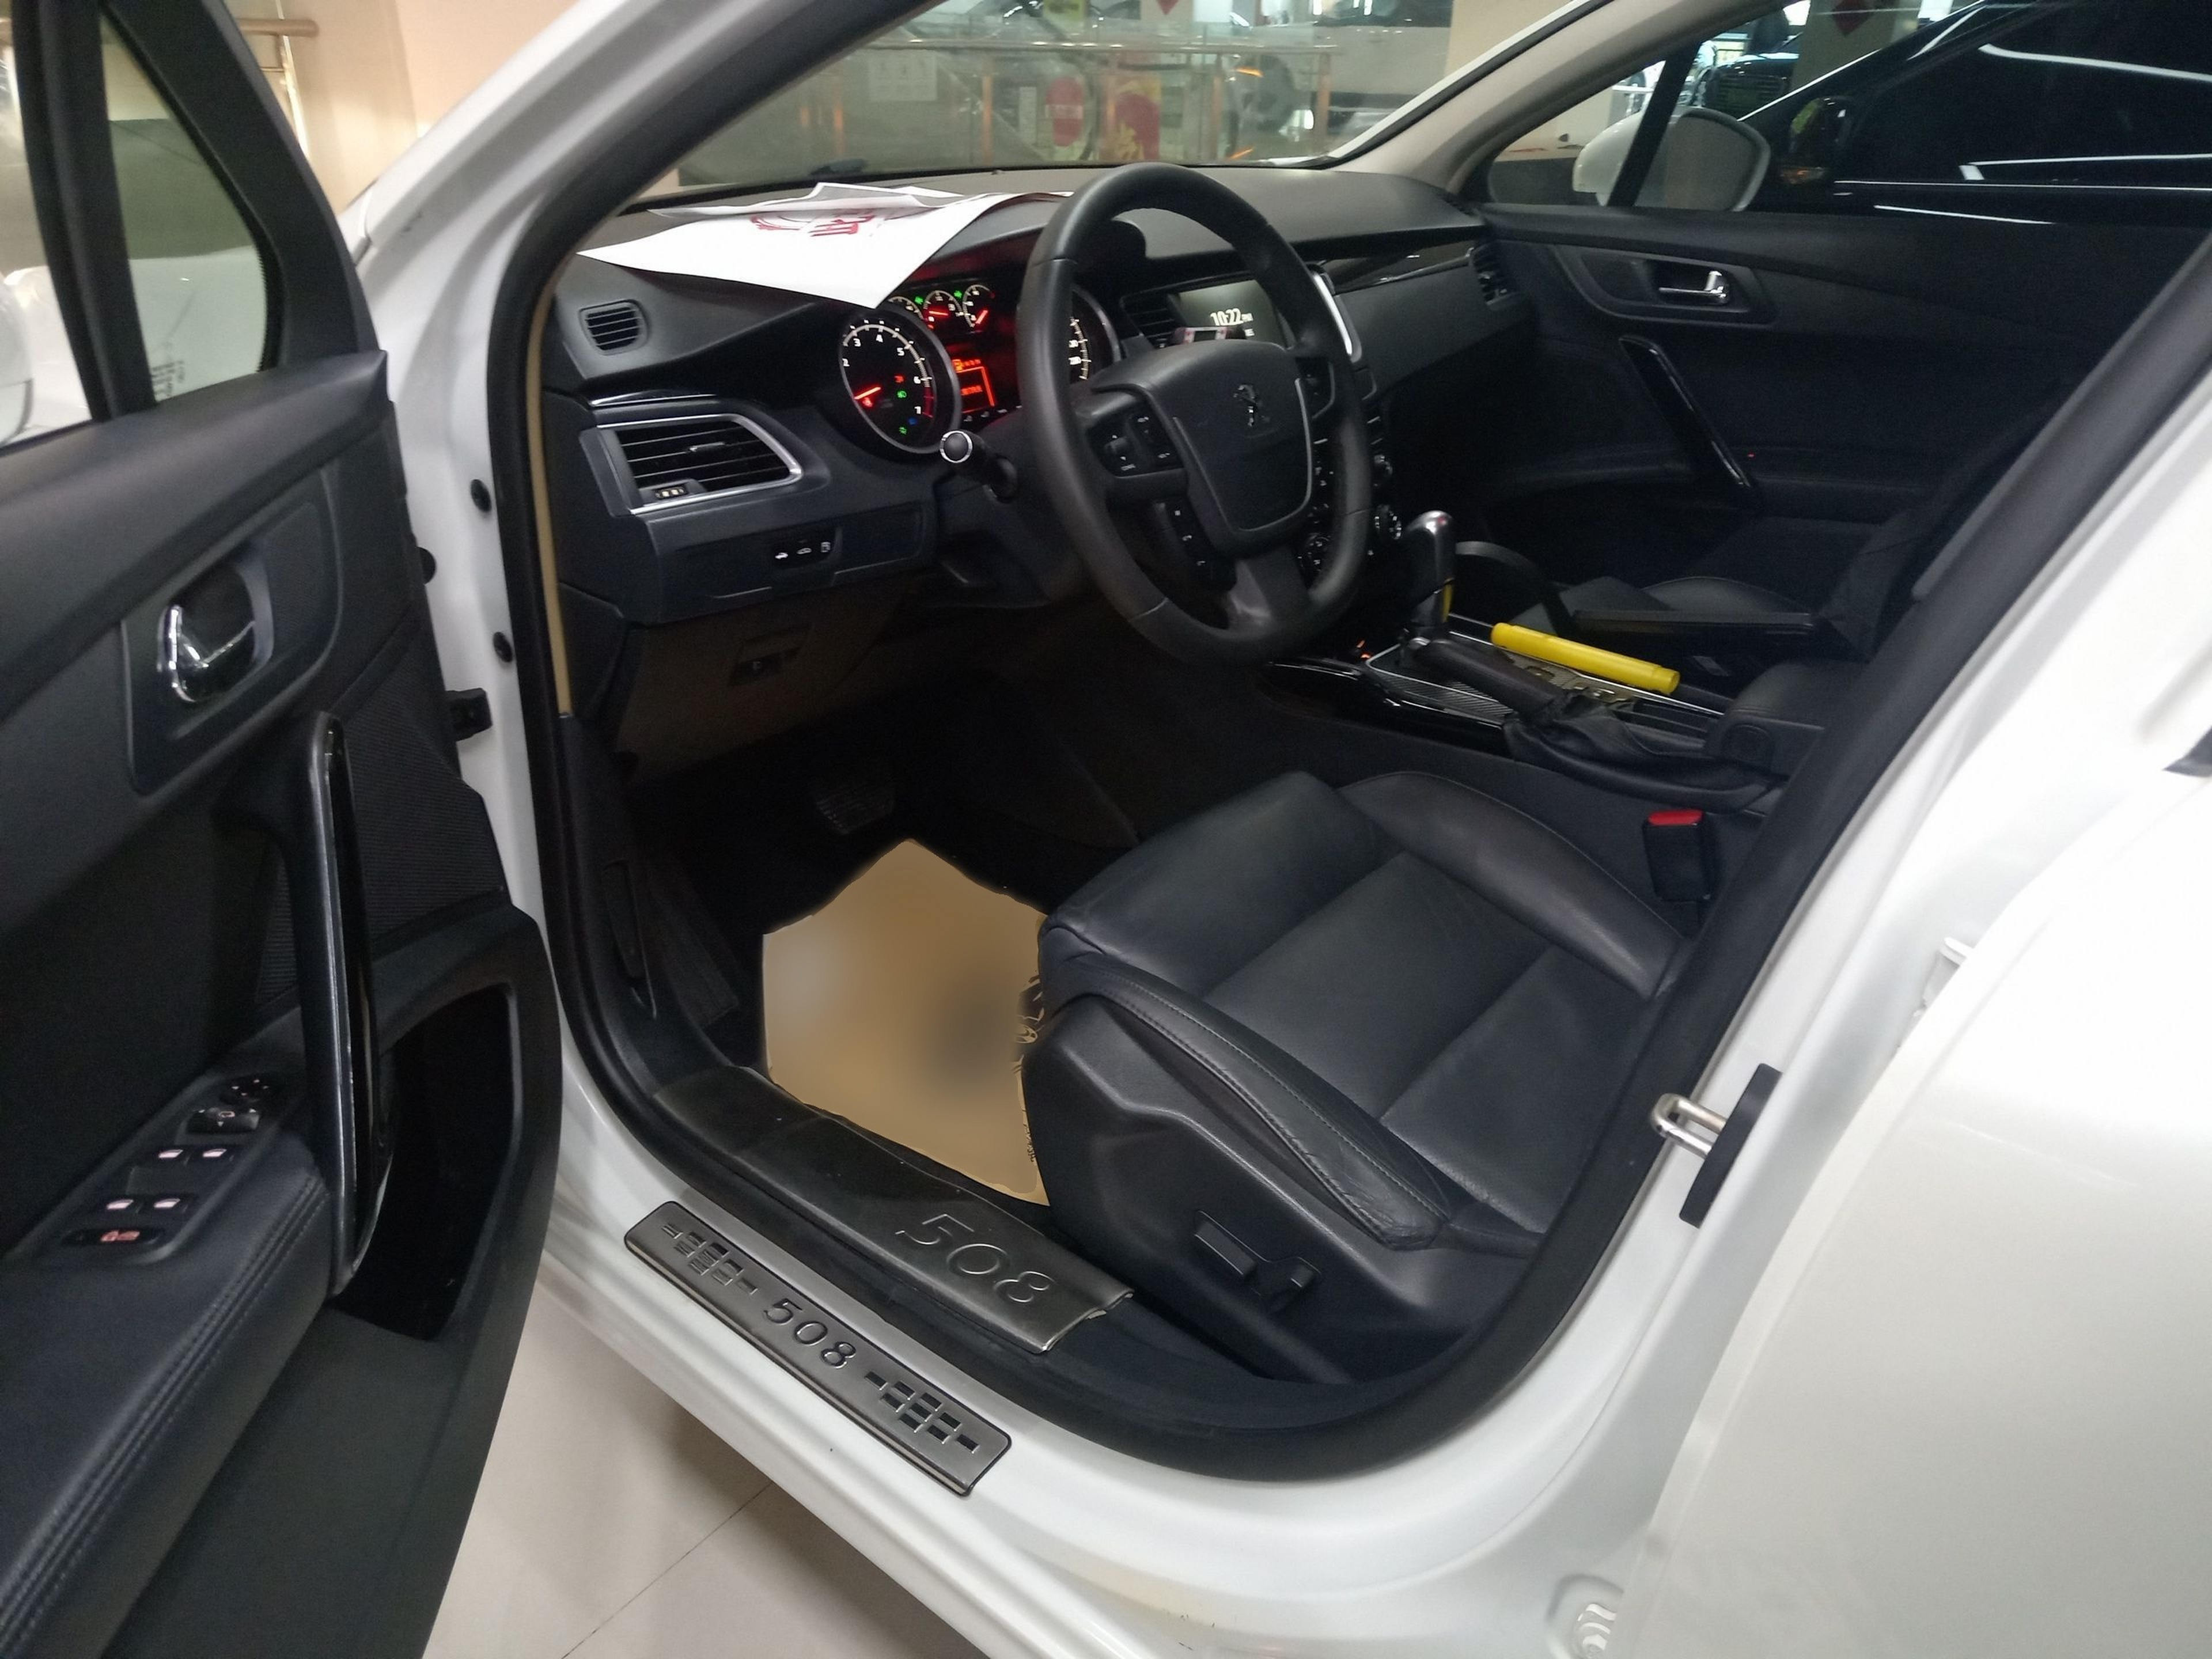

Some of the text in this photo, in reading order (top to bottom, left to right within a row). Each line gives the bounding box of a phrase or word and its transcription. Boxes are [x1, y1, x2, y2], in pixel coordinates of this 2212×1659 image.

[853, 338, 861, 347] 3
[876, 334, 884, 343] 4
[897, 347, 904, 357] 5
[914, 376, 921, 384] 6
[914, 406, 922, 415] 7
[895, 1213, 1056, 1304] 508
[763, 1298, 856, 1369] 508
